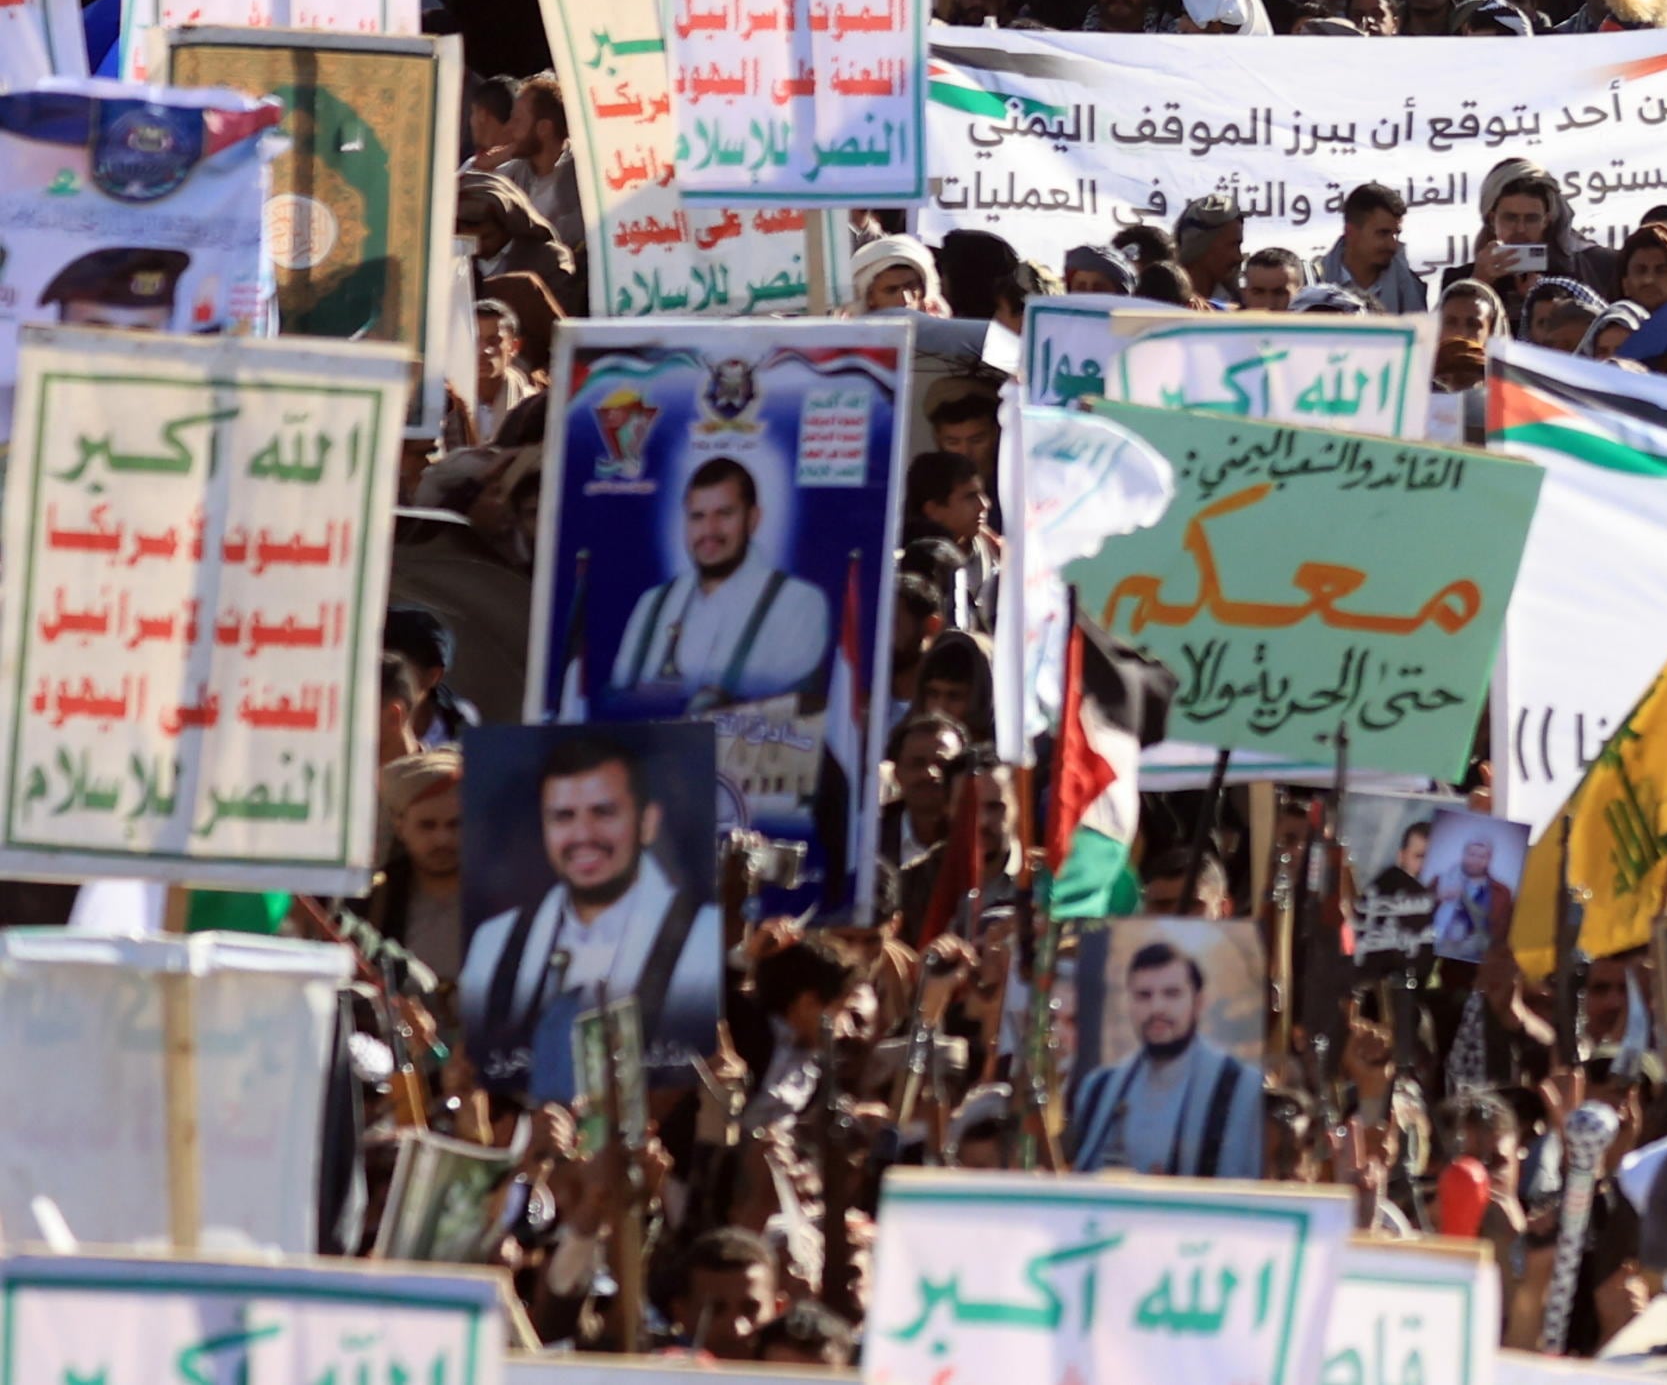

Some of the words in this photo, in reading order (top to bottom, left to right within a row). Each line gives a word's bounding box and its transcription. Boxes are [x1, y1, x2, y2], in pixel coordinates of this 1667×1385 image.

[674, 57, 760, 106] اليهود
[771, 59, 815, 107] على
[831, 55, 907, 96] اللعنة
[968, 99, 1096, 160] اليمني
[1110, 102, 1272, 157] الموقف
[1372, 97, 1416, 150] أن
[1427, 99, 1542, 152] يتوقع
[1555, 79, 1622, 133] أحد
[801, 112, 908, 183] النصر
[1284, 111, 1357, 157] يبرز
[937, 170, 1098, 222] العمليات
[1132, 1240, 1274, 1339] الله
